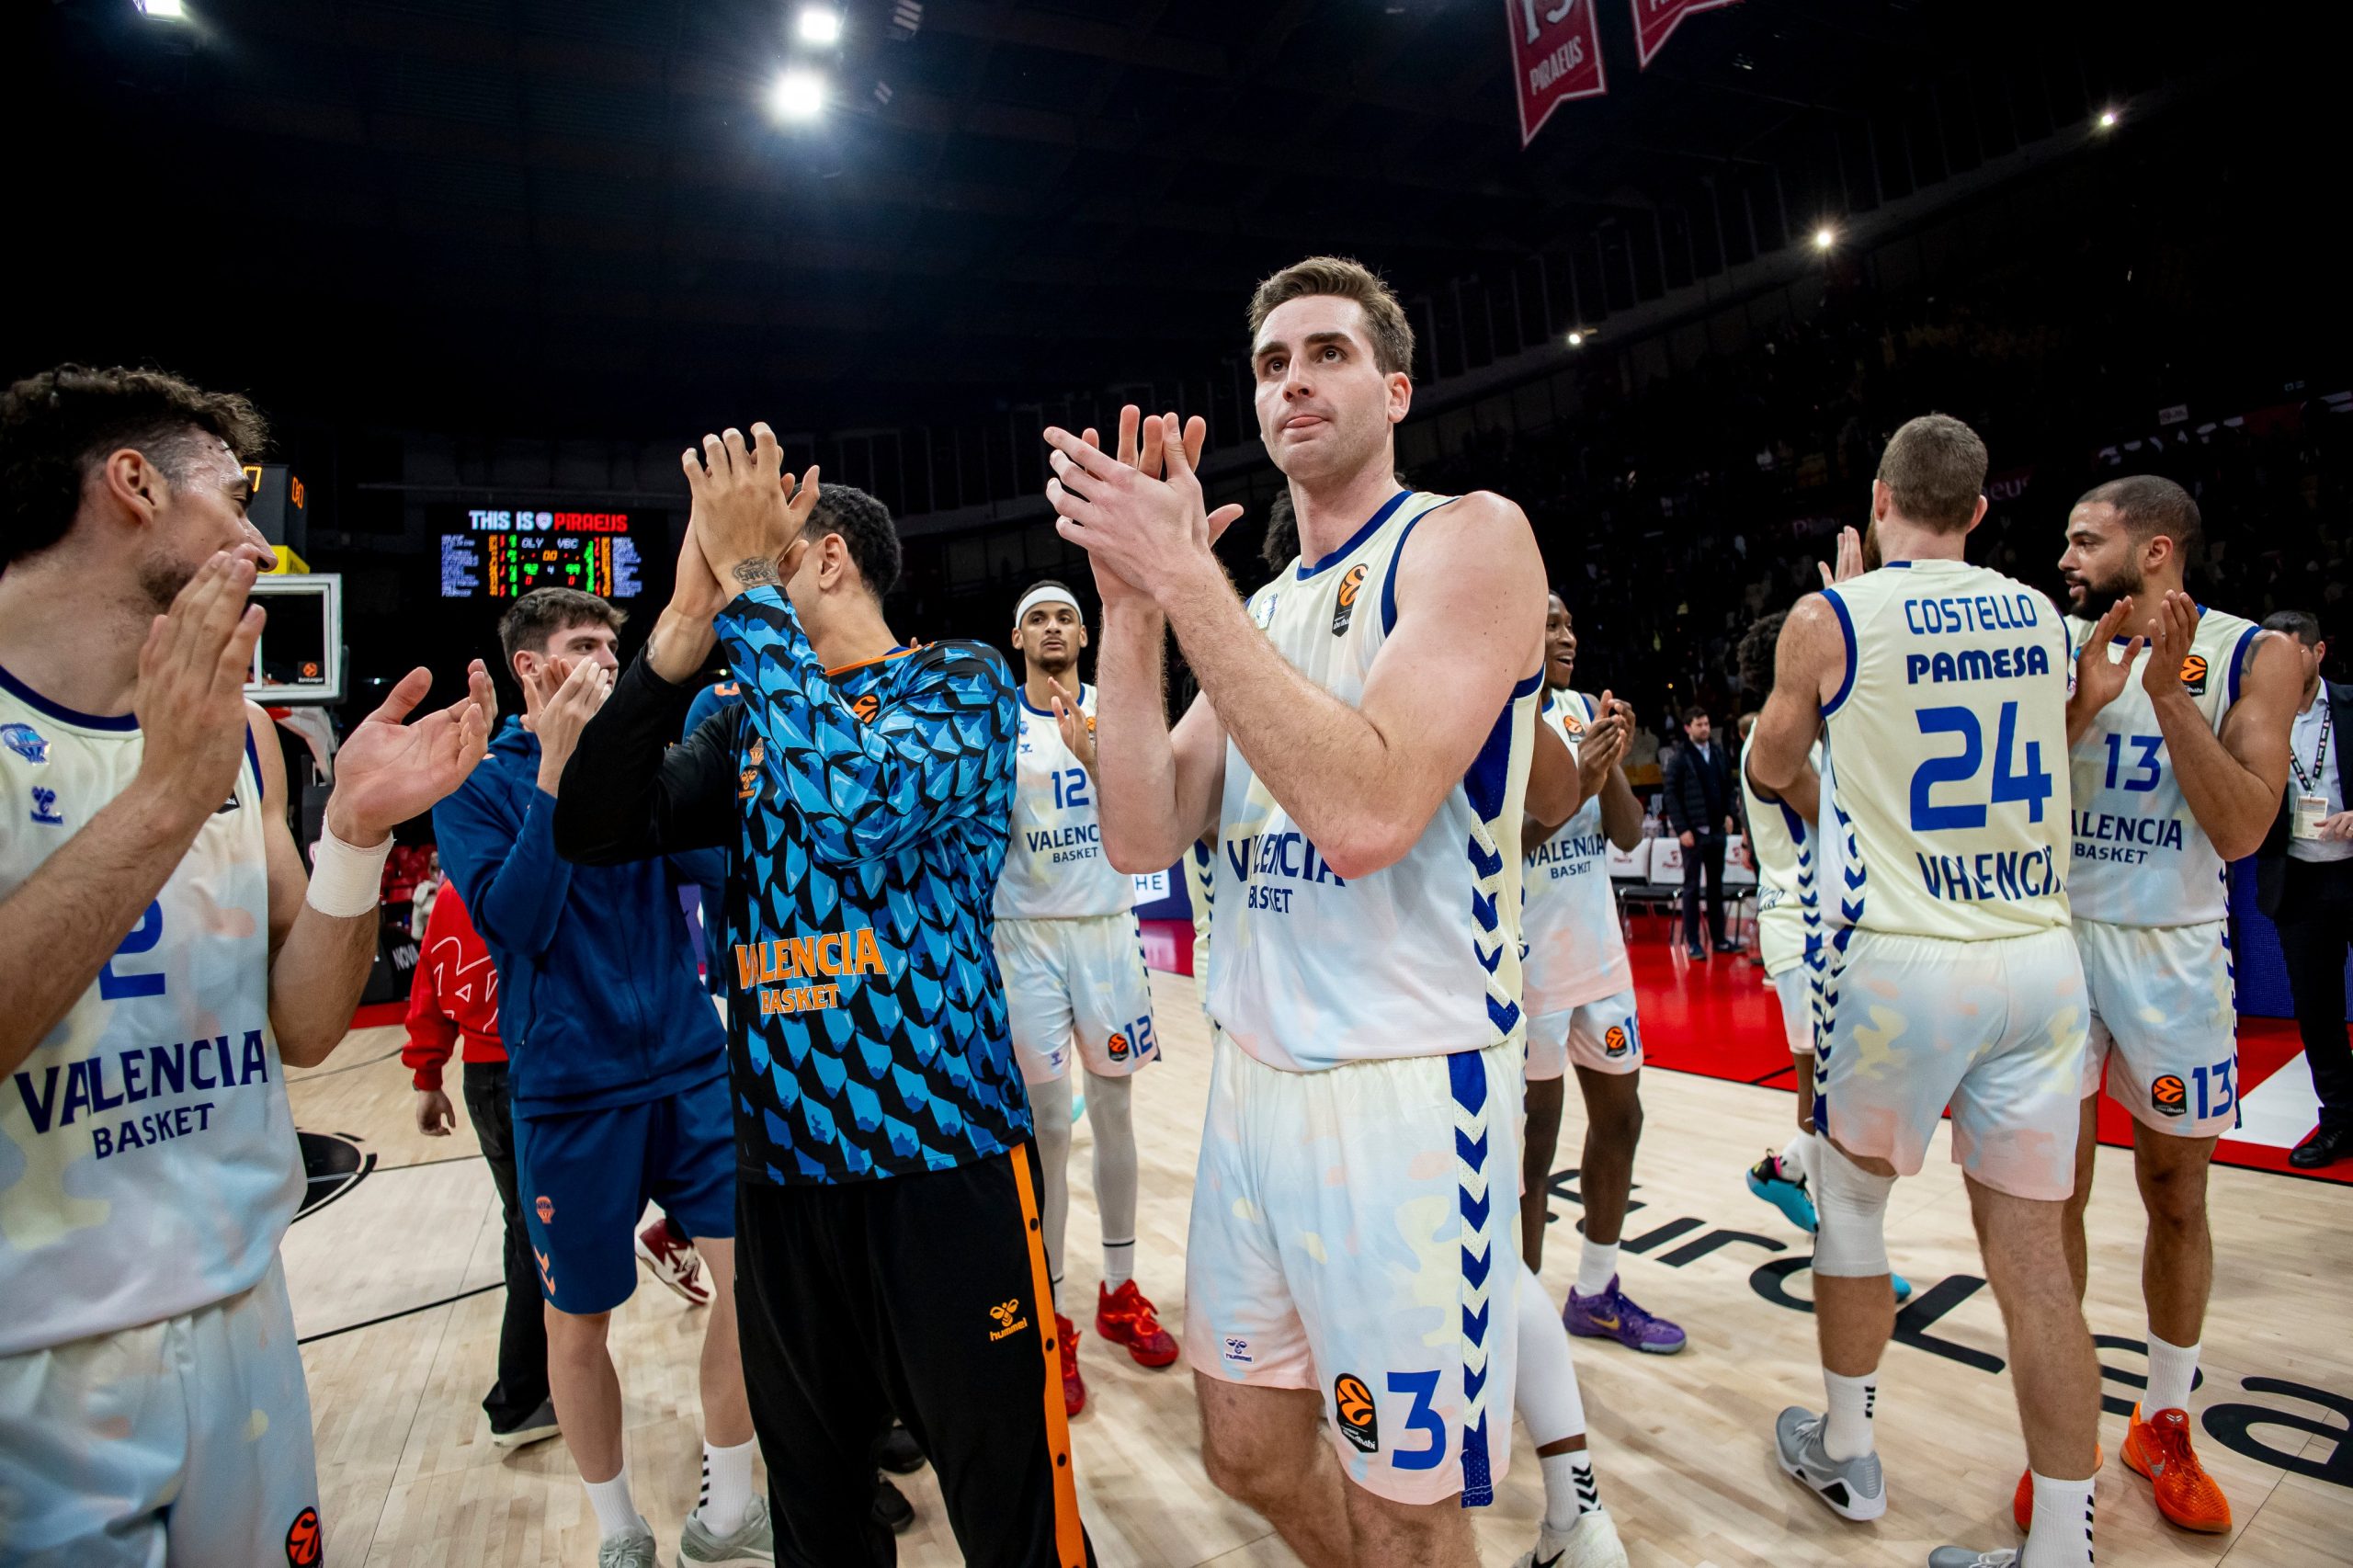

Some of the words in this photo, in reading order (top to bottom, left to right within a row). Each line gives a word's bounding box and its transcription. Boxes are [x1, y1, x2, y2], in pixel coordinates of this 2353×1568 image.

[1529, 35, 1584, 96] PIRAEUS
[469, 510, 511, 530] THIS
[516, 511, 536, 531] IS
[554, 513, 629, 532] PIRAEUS
[521, 537, 544, 549] OLY
[557, 538, 579, 550] VBC
[542, 550, 559, 562] 00
[1904, 594, 2039, 635] COSTELLO
[1906, 645, 2050, 685] PAMESA
[1910, 701, 2052, 832] 24
[2104, 733, 2164, 792] 13
[1051, 767, 1089, 810] 12
[1052, 846, 1099, 864] BASKET
[2075, 842, 2149, 865] BASKET
[98, 897, 166, 1001] 2
[735, 926, 889, 990] VALENCIA
[759, 983, 840, 1015] BASKET
[1124, 1015, 1154, 1058] 12
[13, 1028, 268, 1135] VALENCIA
[2191, 1057, 2234, 1119] 13
[92, 1102, 215, 1161] BASKET
[989, 1316, 1028, 1342] hummel
[1386, 1369, 1447, 1471] 3
